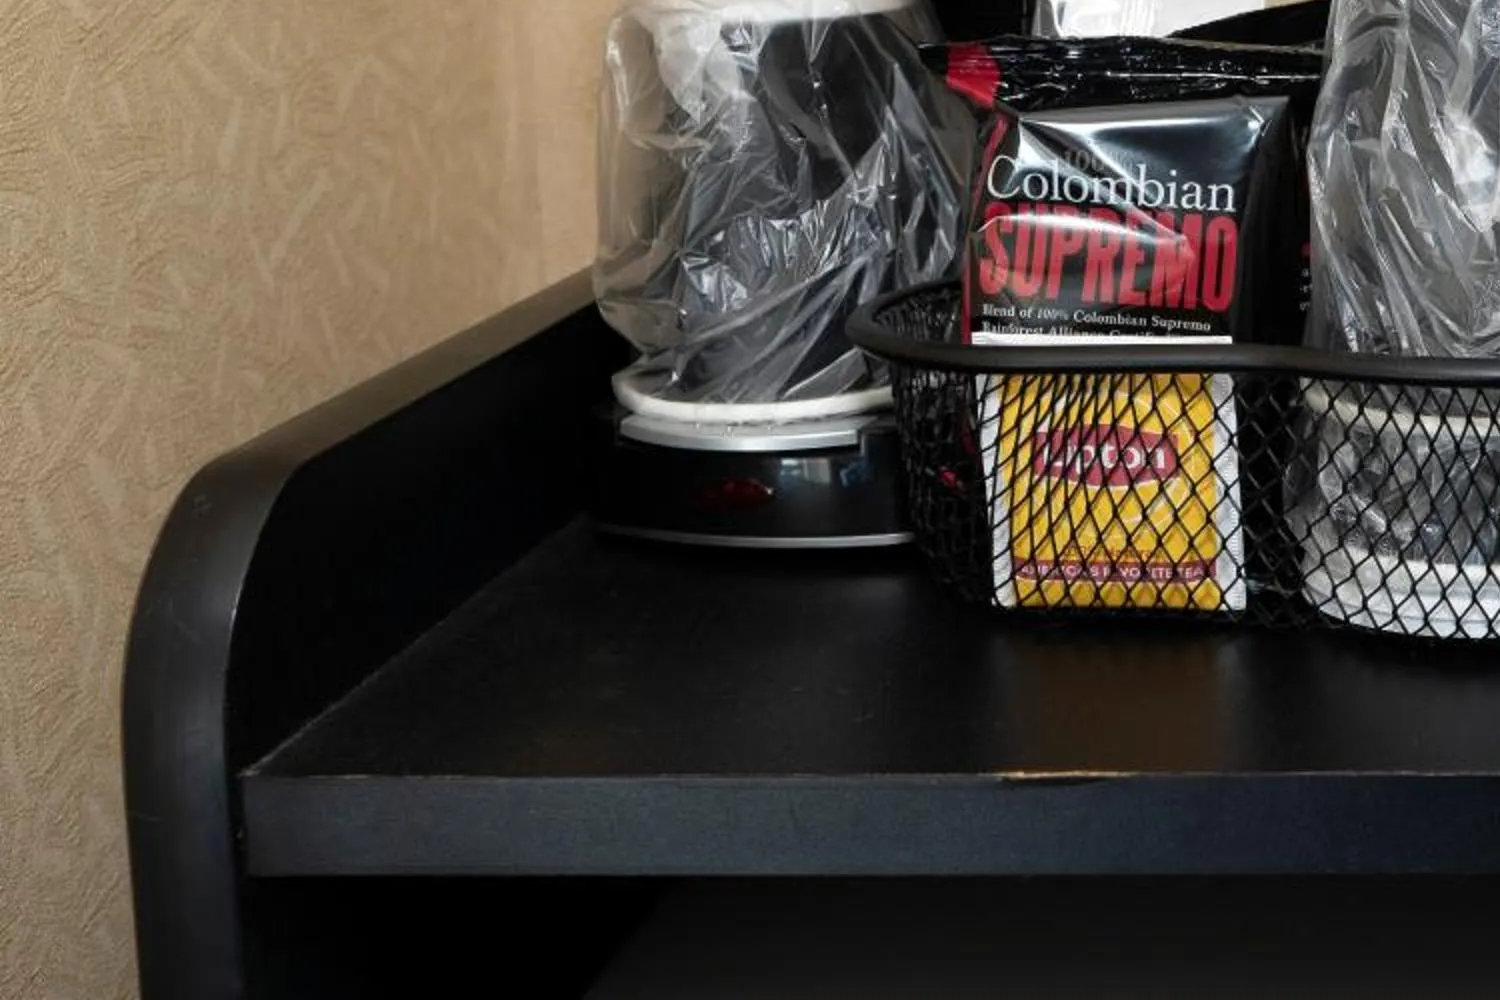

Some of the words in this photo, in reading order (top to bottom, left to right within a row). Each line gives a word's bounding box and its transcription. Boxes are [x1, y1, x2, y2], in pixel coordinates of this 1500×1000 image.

[987, 154, 1237, 213] Colombian
[978, 201, 1238, 313] SUPREMO
[1019, 305, 1033, 319] of
[1073, 308, 1147, 326] Colombian
[1152, 315, 1211, 332] Supremo
